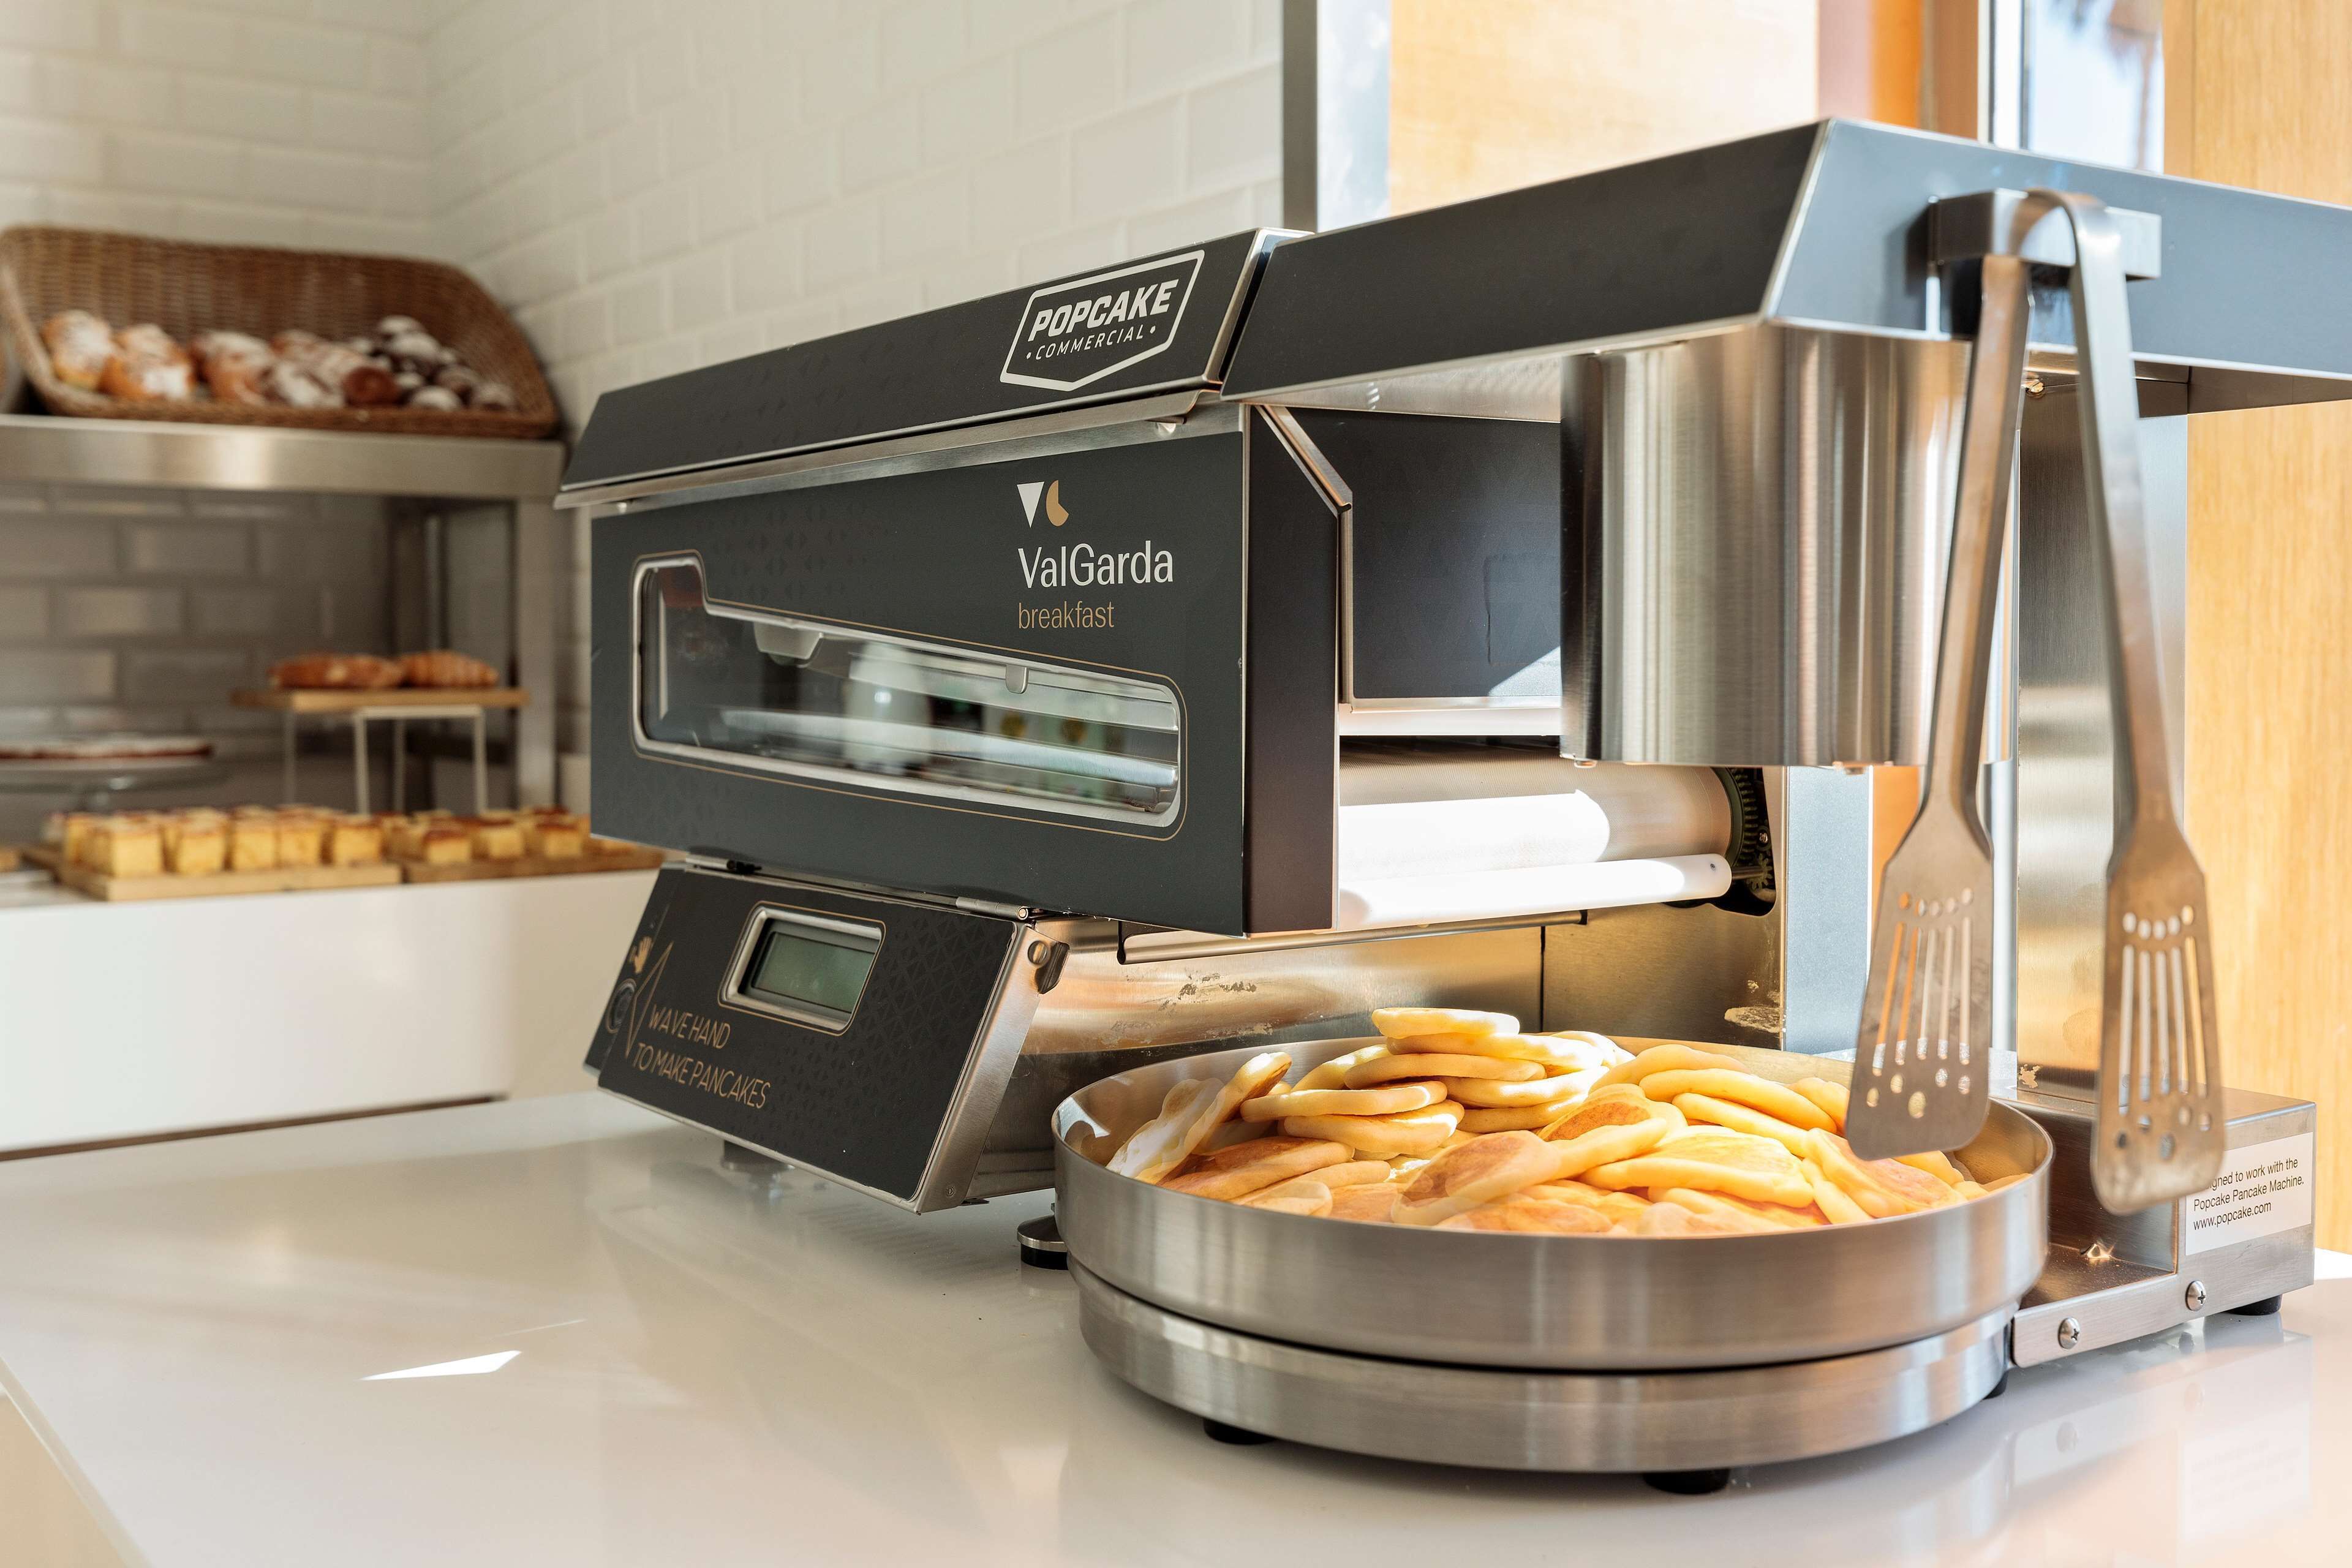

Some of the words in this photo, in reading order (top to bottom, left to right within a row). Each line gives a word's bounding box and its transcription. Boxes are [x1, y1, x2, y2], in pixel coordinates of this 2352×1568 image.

[1028, 279, 1179, 342] POPCAKE
[1035, 325, 1144, 360] COMMERCIAL
[1017, 540, 1174, 589] ValGarda
[1018, 600, 1115, 629] breakfast
[649, 1004, 693, 1039] WAVE
[688, 1014, 731, 1049] HAND
[632, 1042, 654, 1071] TO
[650, 1049, 694, 1085] MAKE
[688, 1060, 771, 1109] PANCAKES
[2235, 1170, 2244, 1183] to
[2245, 1164, 2266, 1180] work
[2267, 1160, 2284, 1175] with
[2286, 1158, 2298, 1170] the
[2193, 1192, 2231, 1212] Popcake
[2233, 1183, 2267, 1202] Pancake
[2269, 1175, 2305, 1193] Machine.
[2193, 1201, 2272, 1231] www.popcake.com
